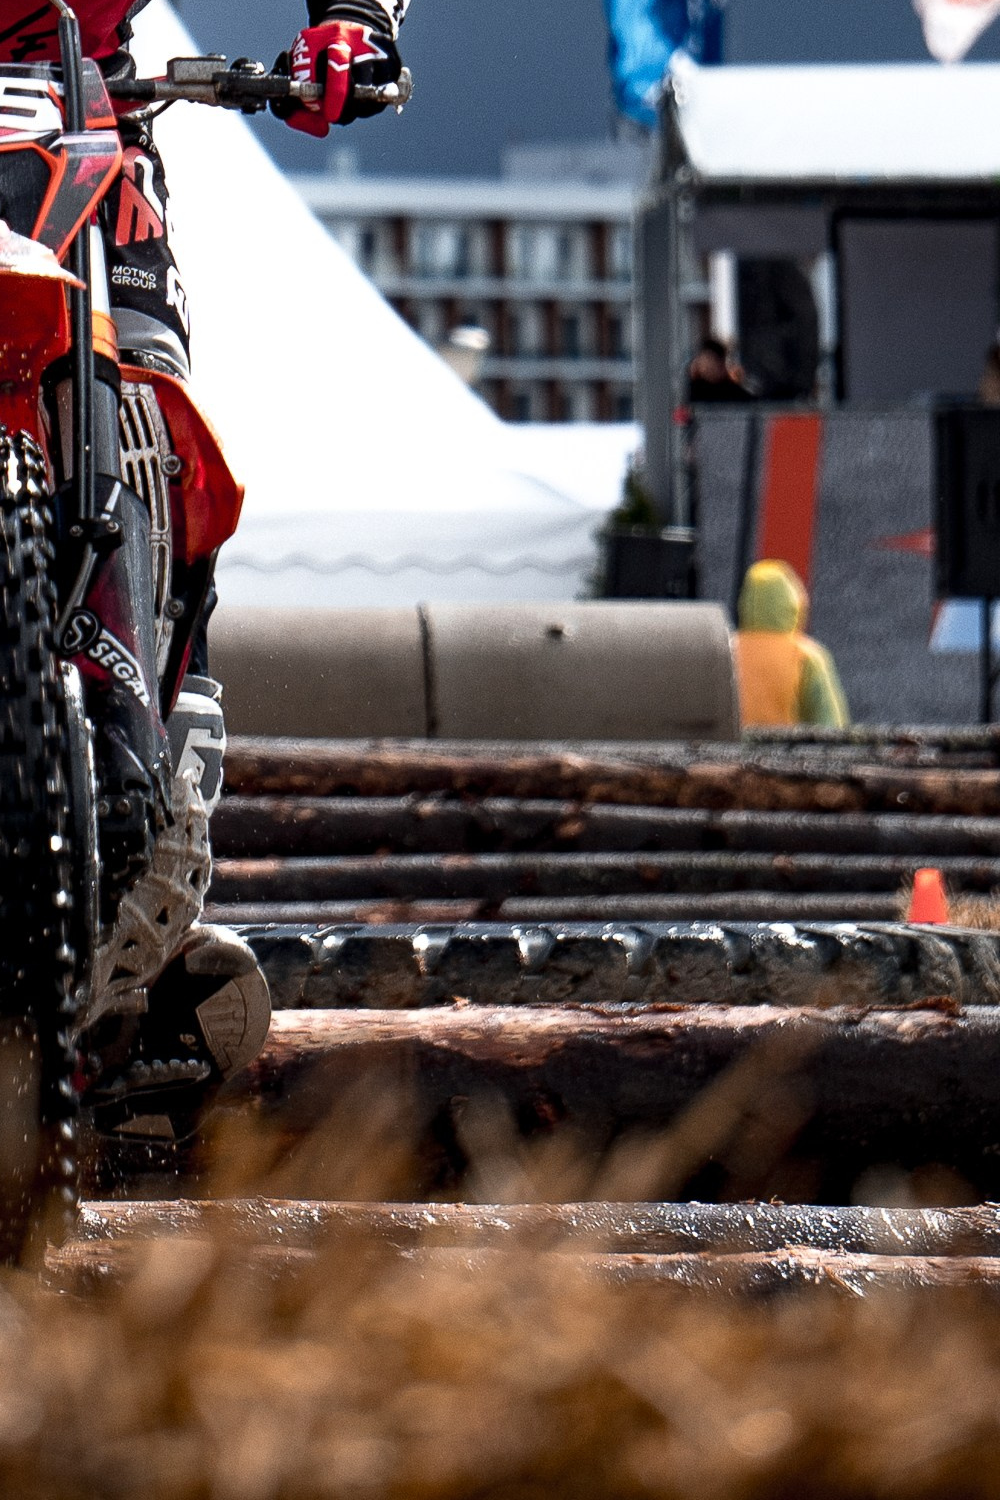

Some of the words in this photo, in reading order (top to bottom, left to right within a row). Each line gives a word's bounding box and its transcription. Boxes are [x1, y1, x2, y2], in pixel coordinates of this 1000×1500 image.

[111, 265, 157, 282] MOTIKO
[111, 275, 157, 290] GROUP
[88, 642, 150, 707] SEGAL
